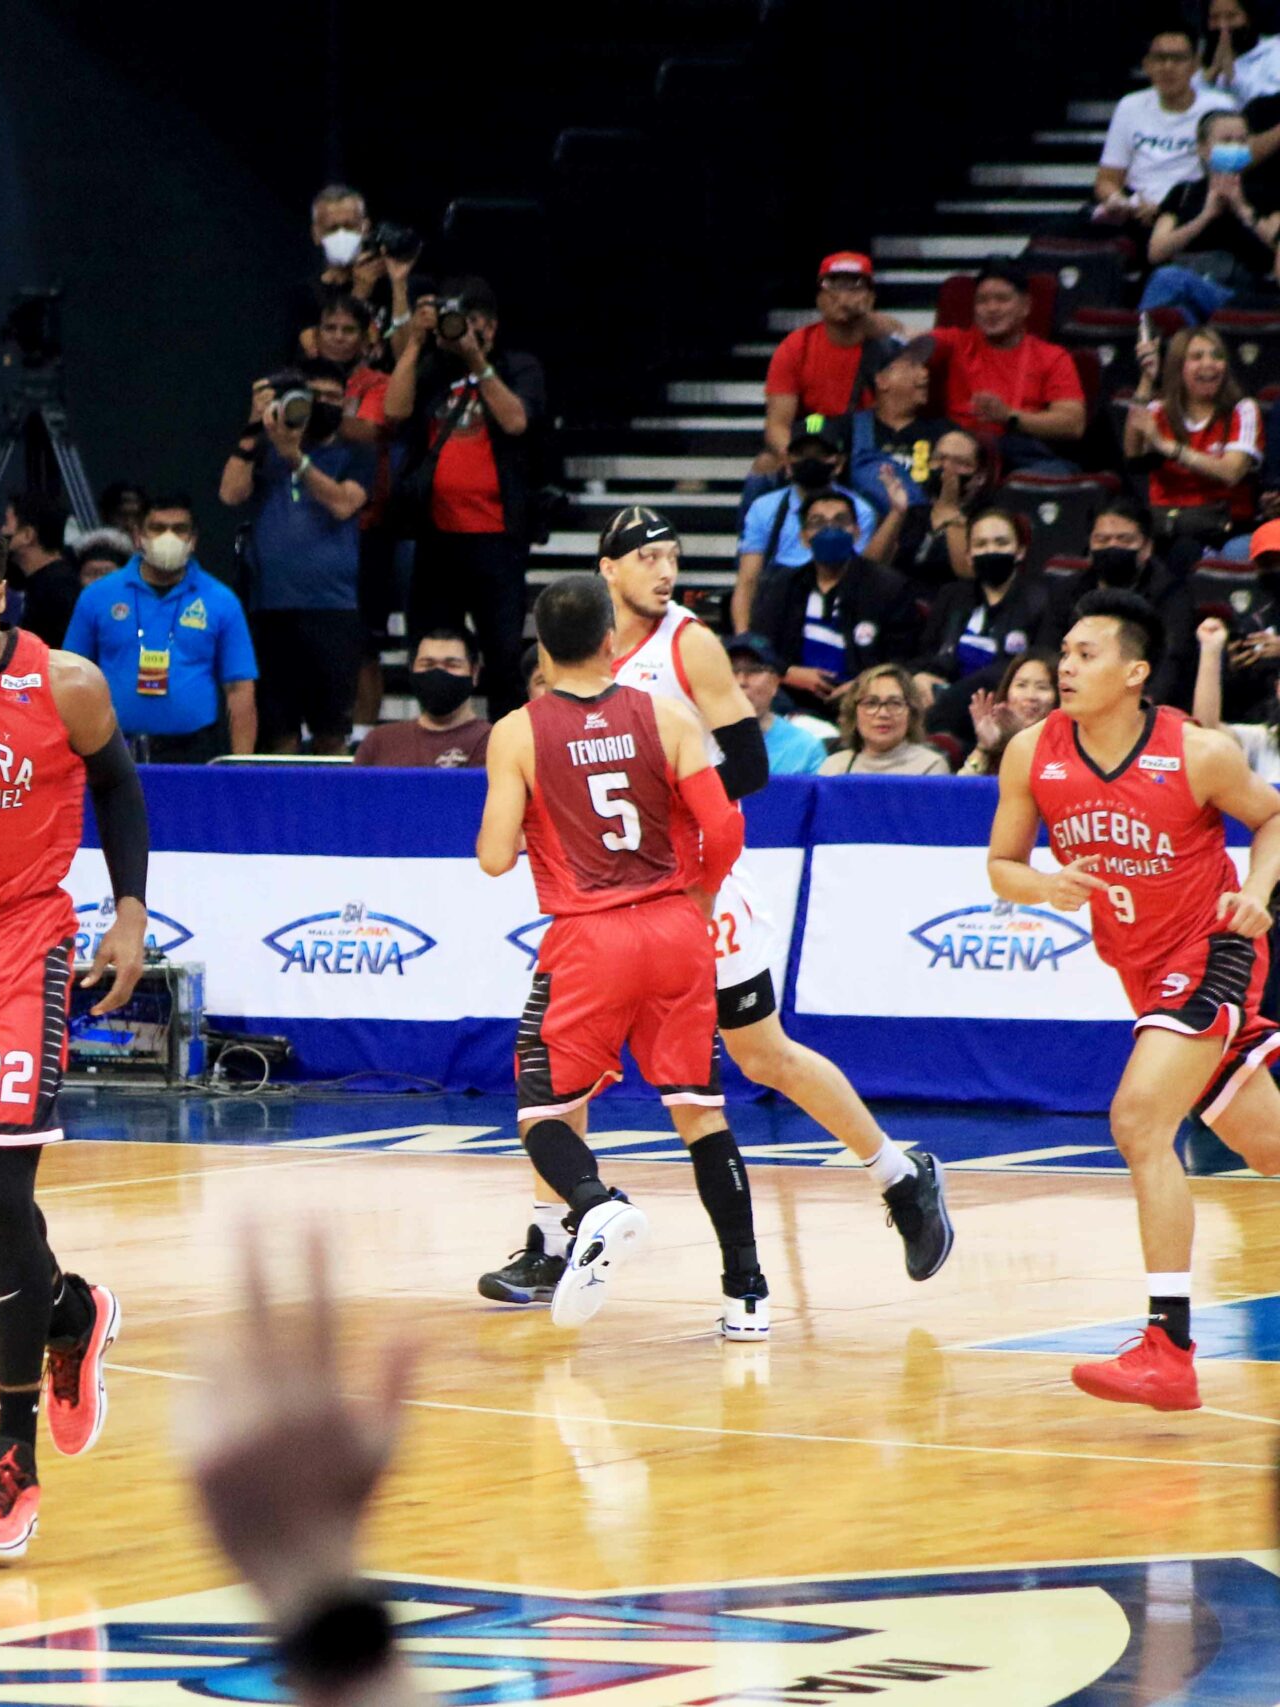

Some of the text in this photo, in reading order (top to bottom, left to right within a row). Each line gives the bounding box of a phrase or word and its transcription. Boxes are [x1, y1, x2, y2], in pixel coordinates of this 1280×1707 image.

[566, 733, 637, 767] TENORIO
[586, 771, 642, 852] 5
[1104, 856, 1173, 877] MIGUEL
[1108, 884, 1136, 924] 9
[307, 928, 334, 936] MALL
[280, 939, 405, 976] ARENA
[927, 933, 1060, 972] ARENA
